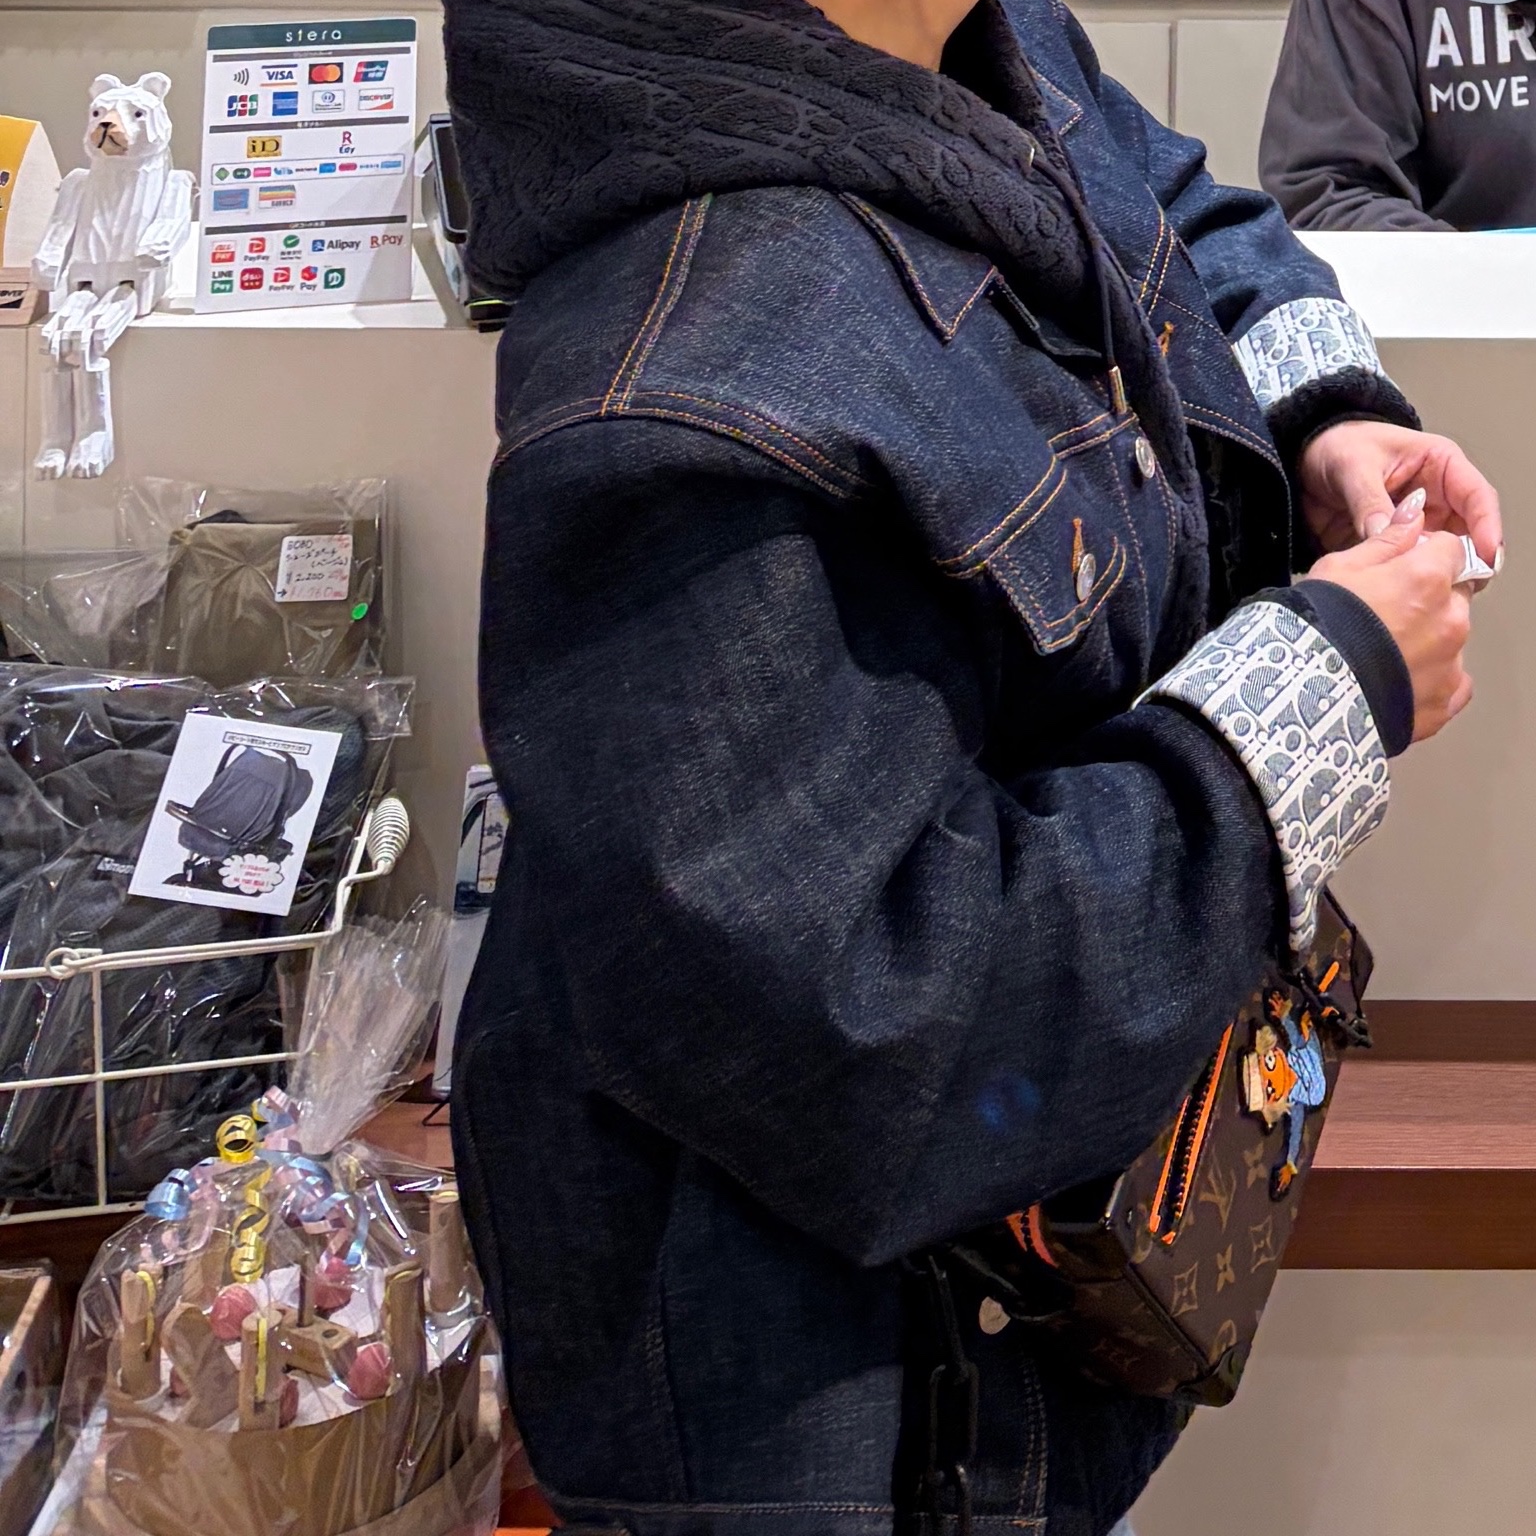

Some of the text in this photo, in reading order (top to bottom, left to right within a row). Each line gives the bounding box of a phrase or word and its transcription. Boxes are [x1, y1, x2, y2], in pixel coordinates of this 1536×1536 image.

[286, 28, 342, 42] stera
[266, 71, 294, 81] VISA
[1430, 75, 1529, 113] MOVE
[251, 139, 280, 153] iD
[326, 238, 361, 251] Alipay
[382, 234, 404, 246] Pay
[244, 254, 270, 262] PayPay
[212, 270, 233, 279] LINE
[213, 283, 231, 292] Pay
[269, 283, 295, 291] PayPay
[300, 282, 317, 292] Pay
